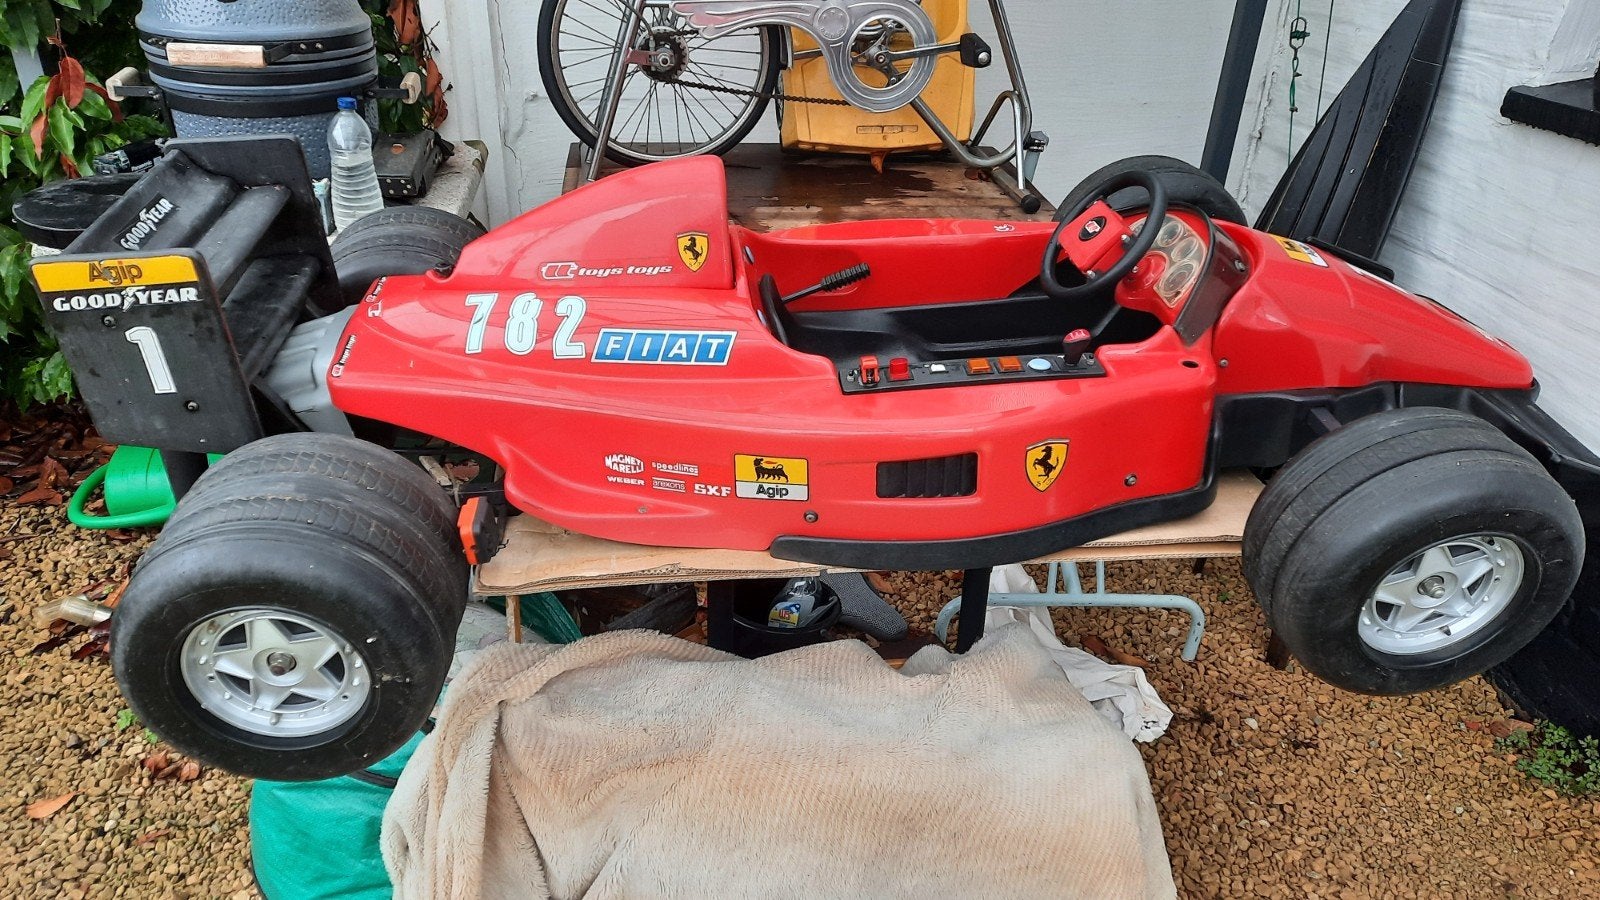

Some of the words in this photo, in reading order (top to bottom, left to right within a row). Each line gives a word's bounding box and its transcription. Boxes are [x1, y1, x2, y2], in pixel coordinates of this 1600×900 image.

[120, 198, 173, 251] GOODYEAR
[88, 260, 143, 287] Agip
[578, 267, 624, 278] toys
[626, 265, 673, 276] toys
[52, 287, 199, 312] GOODYEAR
[602, 333, 728, 361] FIAT
[124, 326, 178, 395] 1
[604, 453, 644, 467] MAGNETI
[606, 475, 645, 487] WEBER
[756, 483, 789, 499] Agip
